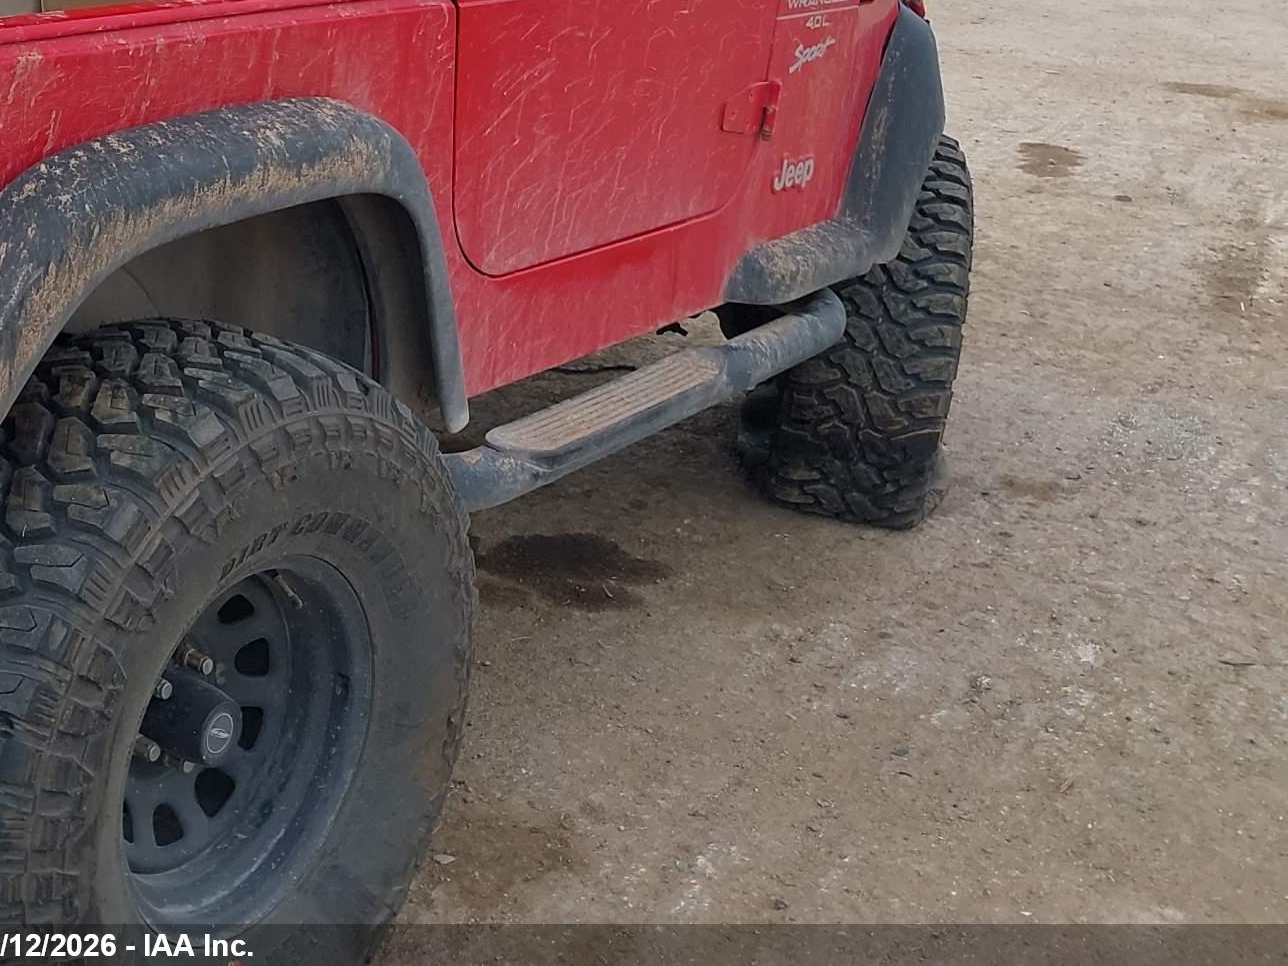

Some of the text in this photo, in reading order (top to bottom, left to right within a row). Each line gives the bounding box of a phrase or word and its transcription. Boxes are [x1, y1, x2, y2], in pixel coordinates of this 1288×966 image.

[789, 35, 835, 73] Sport
[774, 158, 814, 190] Jeep
[217, 511, 419, 620] DIRT COMMA
